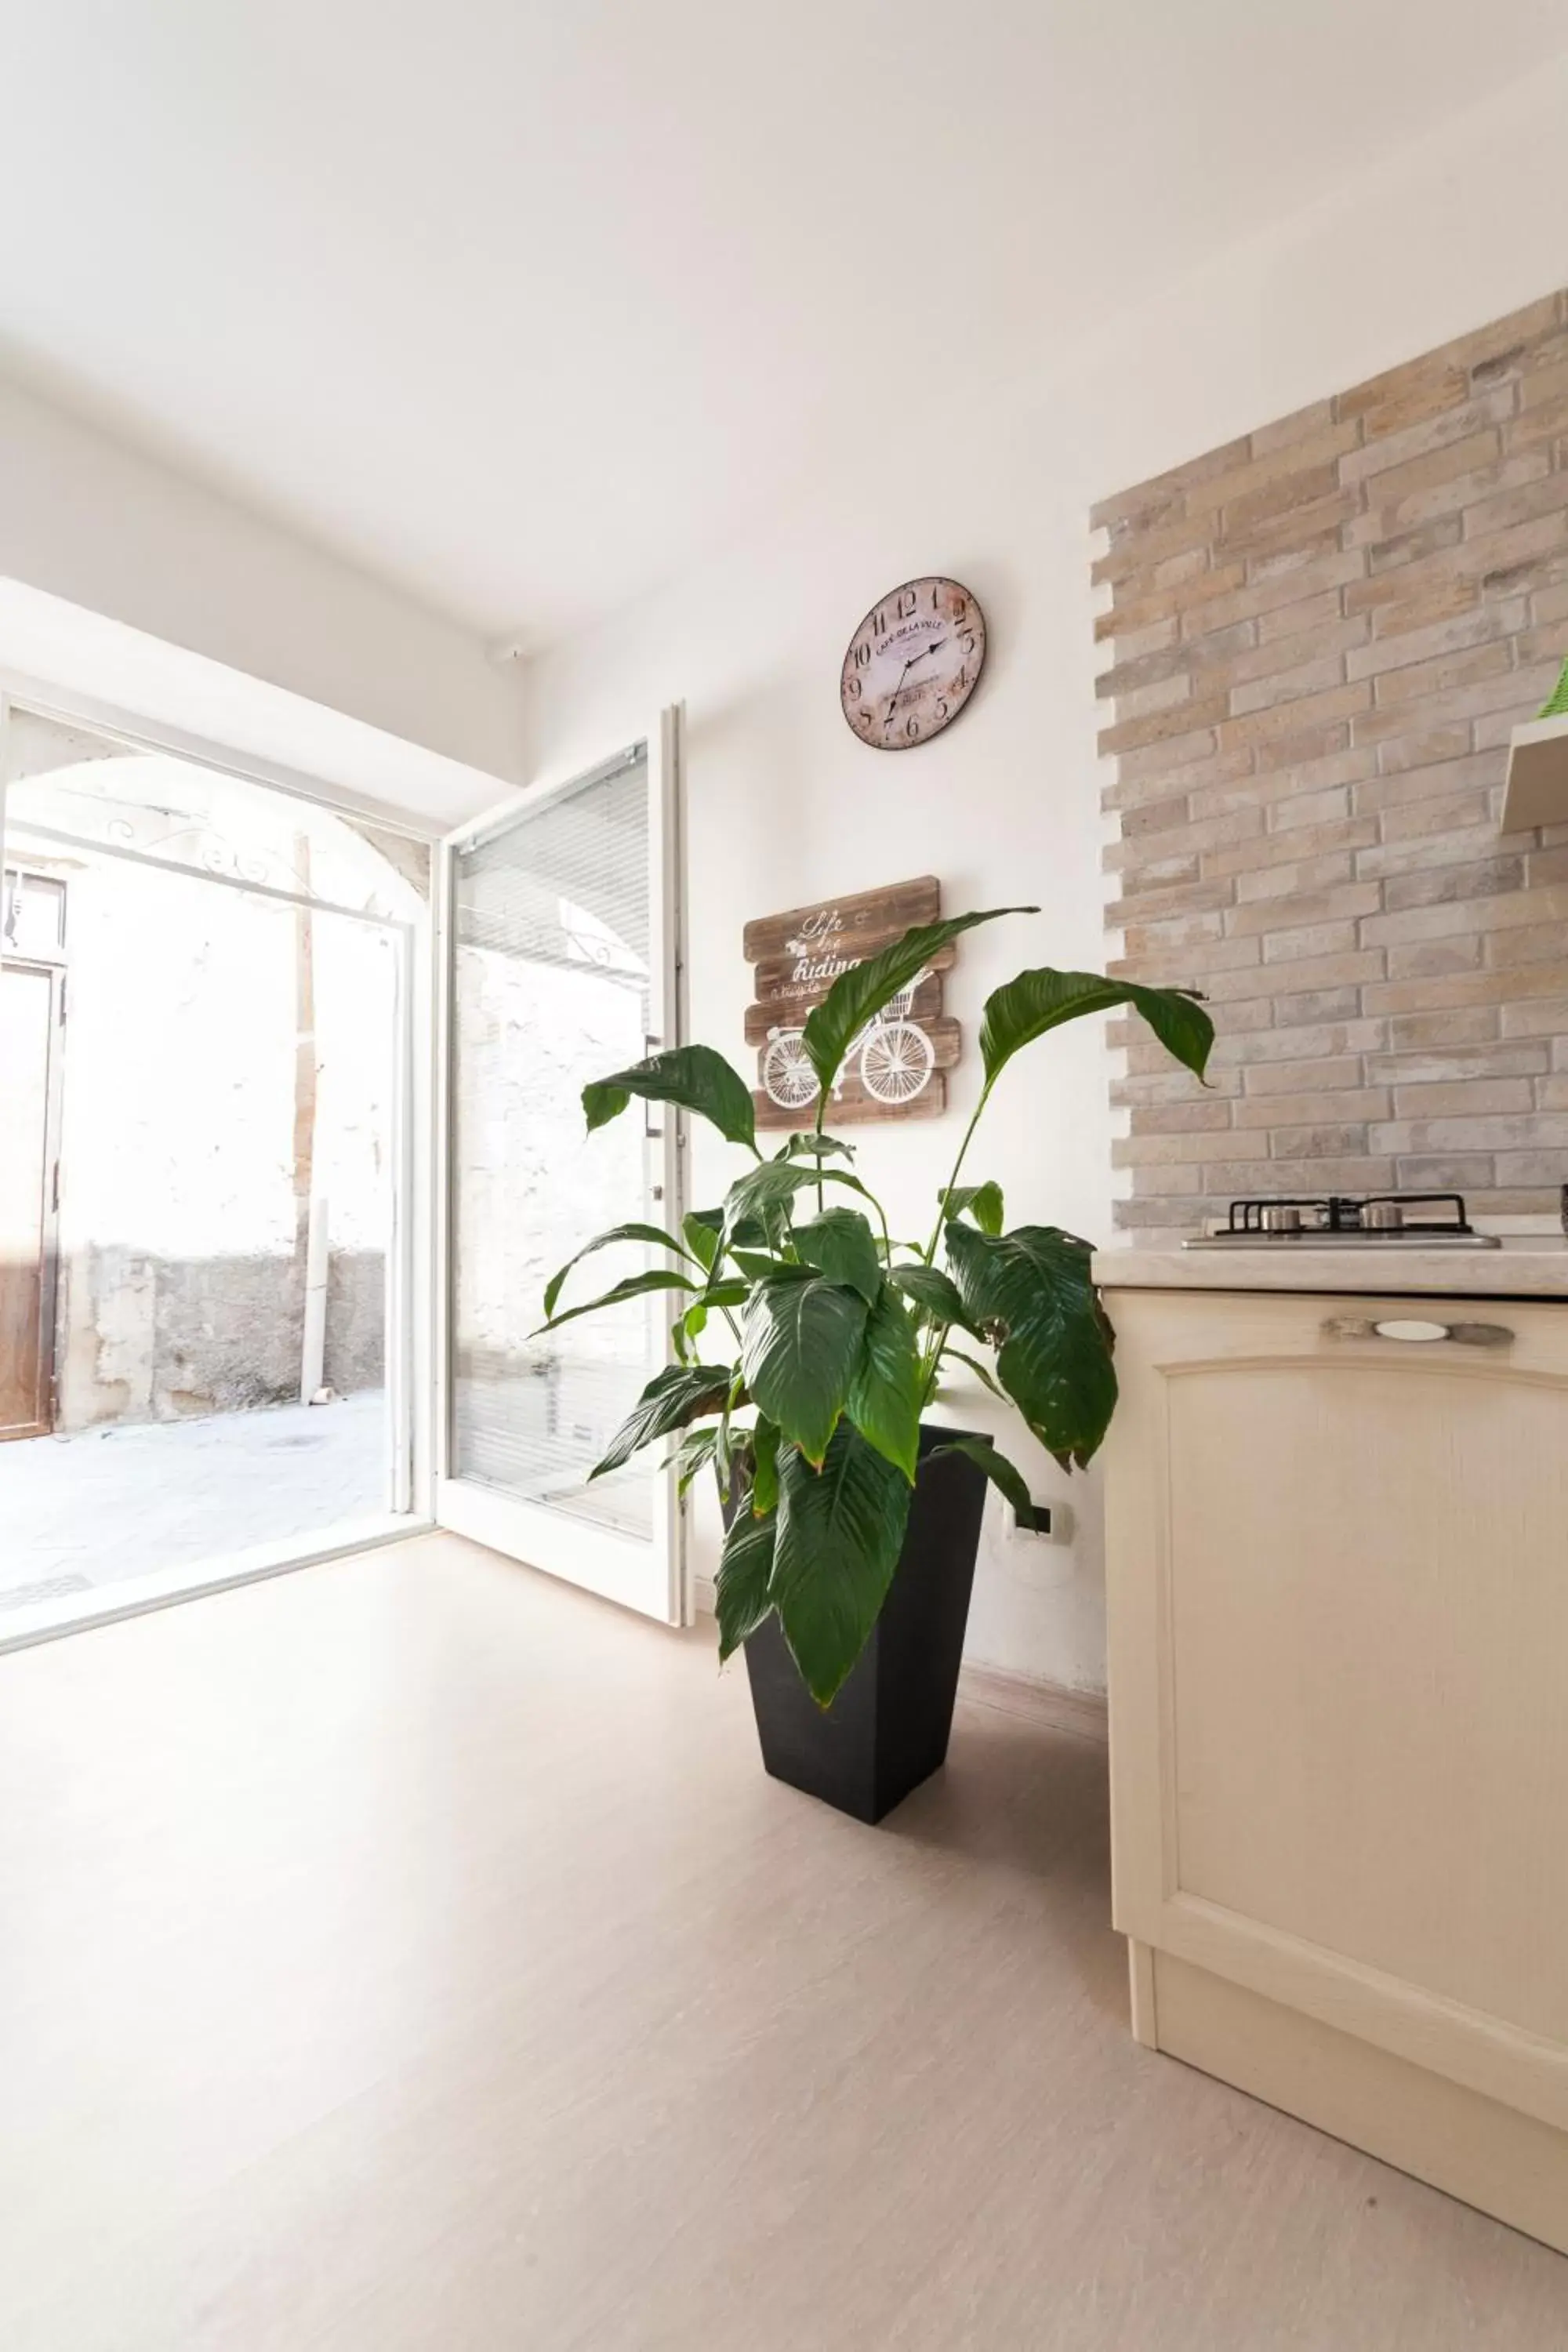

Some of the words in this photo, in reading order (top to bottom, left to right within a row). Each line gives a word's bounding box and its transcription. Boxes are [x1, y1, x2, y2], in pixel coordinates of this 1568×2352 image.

[897, 590, 916, 619] 12
[931, 586, 938, 610] 1
[873, 613, 887, 637] 11
[854, 643, 871, 669] 10
[953, 665, 966, 688] 4
[849, 678, 862, 701] 9
[906, 714, 919, 738] 6
[797, 909, 846, 946] Life
